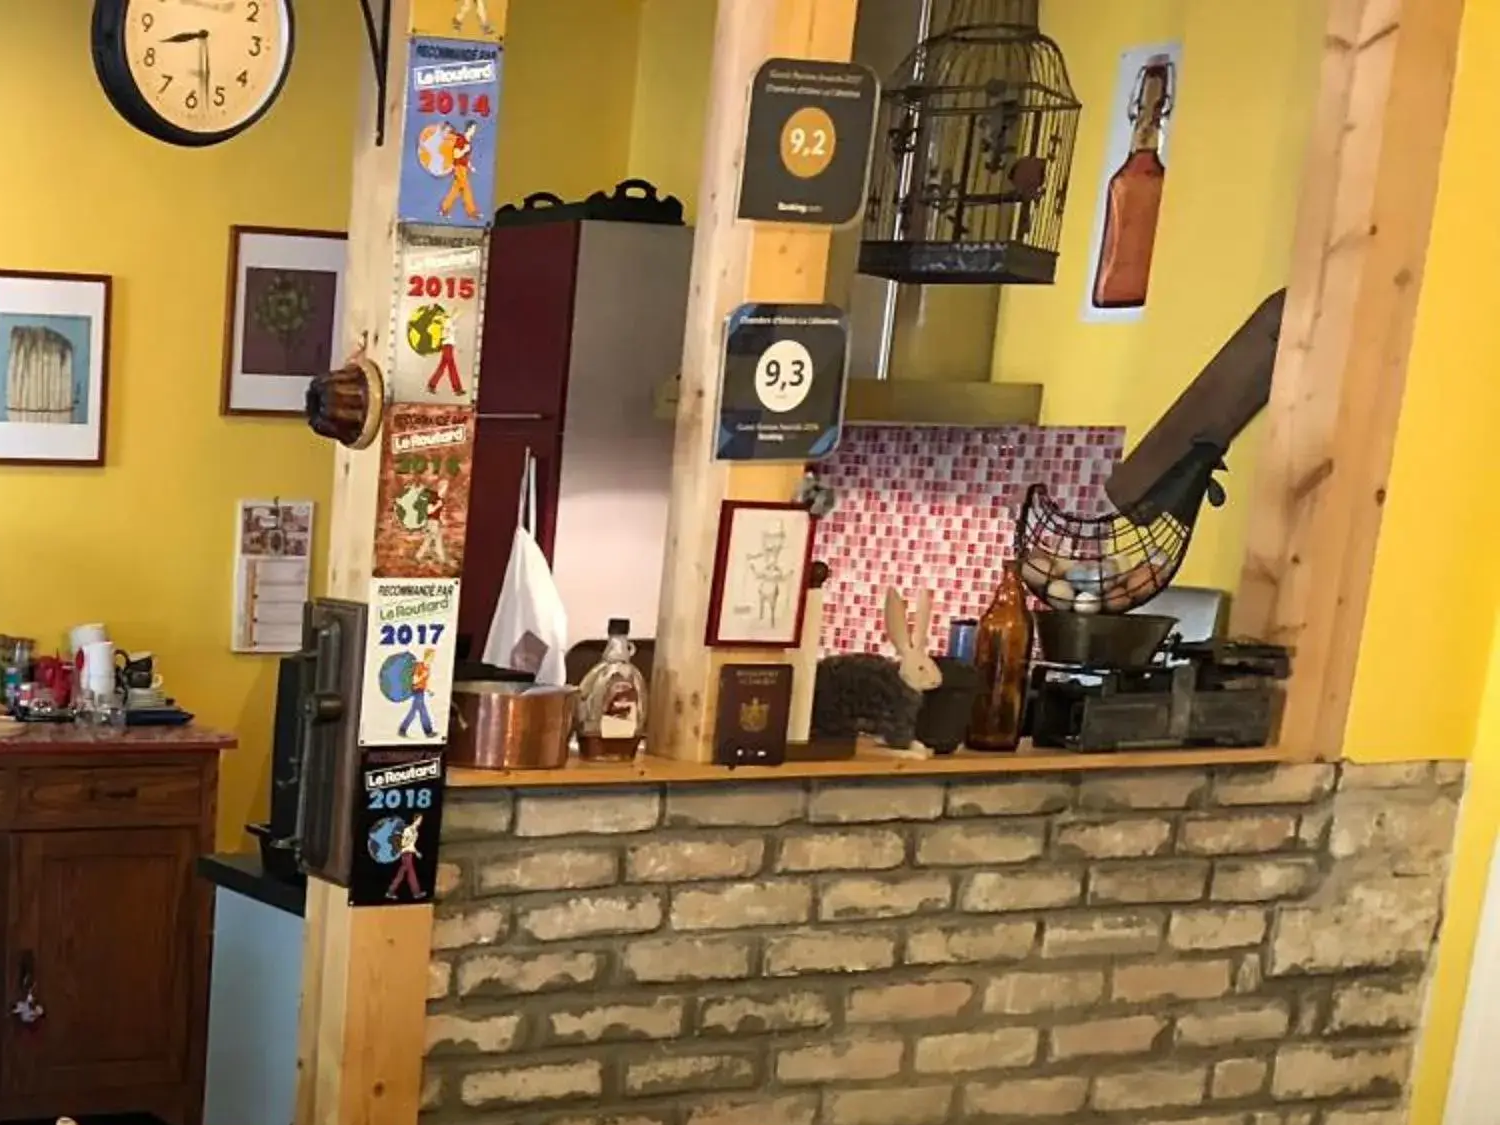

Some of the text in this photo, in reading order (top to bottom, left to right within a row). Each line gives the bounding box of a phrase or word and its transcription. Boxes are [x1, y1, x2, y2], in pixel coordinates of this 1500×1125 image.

[246, 1, 260, 22] 2
[141, 13, 154, 32] 9
[248, 36, 261, 56] 3
[143, 47, 156, 67] 8
[158, 74, 173, 94] 7
[236, 69, 249, 87] 4
[417, 63, 492, 85] Le Routard
[185, 90, 198, 109] 6
[213, 87, 226, 107] 5
[417, 91, 491, 117] 2014
[790, 127, 827, 157] 9,2
[407, 275, 475, 300] 2015
[765, 359, 805, 391] 9,3
[395, 427, 464, 449] Le Routard
[380, 595, 448, 620] Le Routard
[379, 624, 445, 645] 2017
[368, 761, 437, 787] Le Routard
[367, 788, 432, 809] 2018
